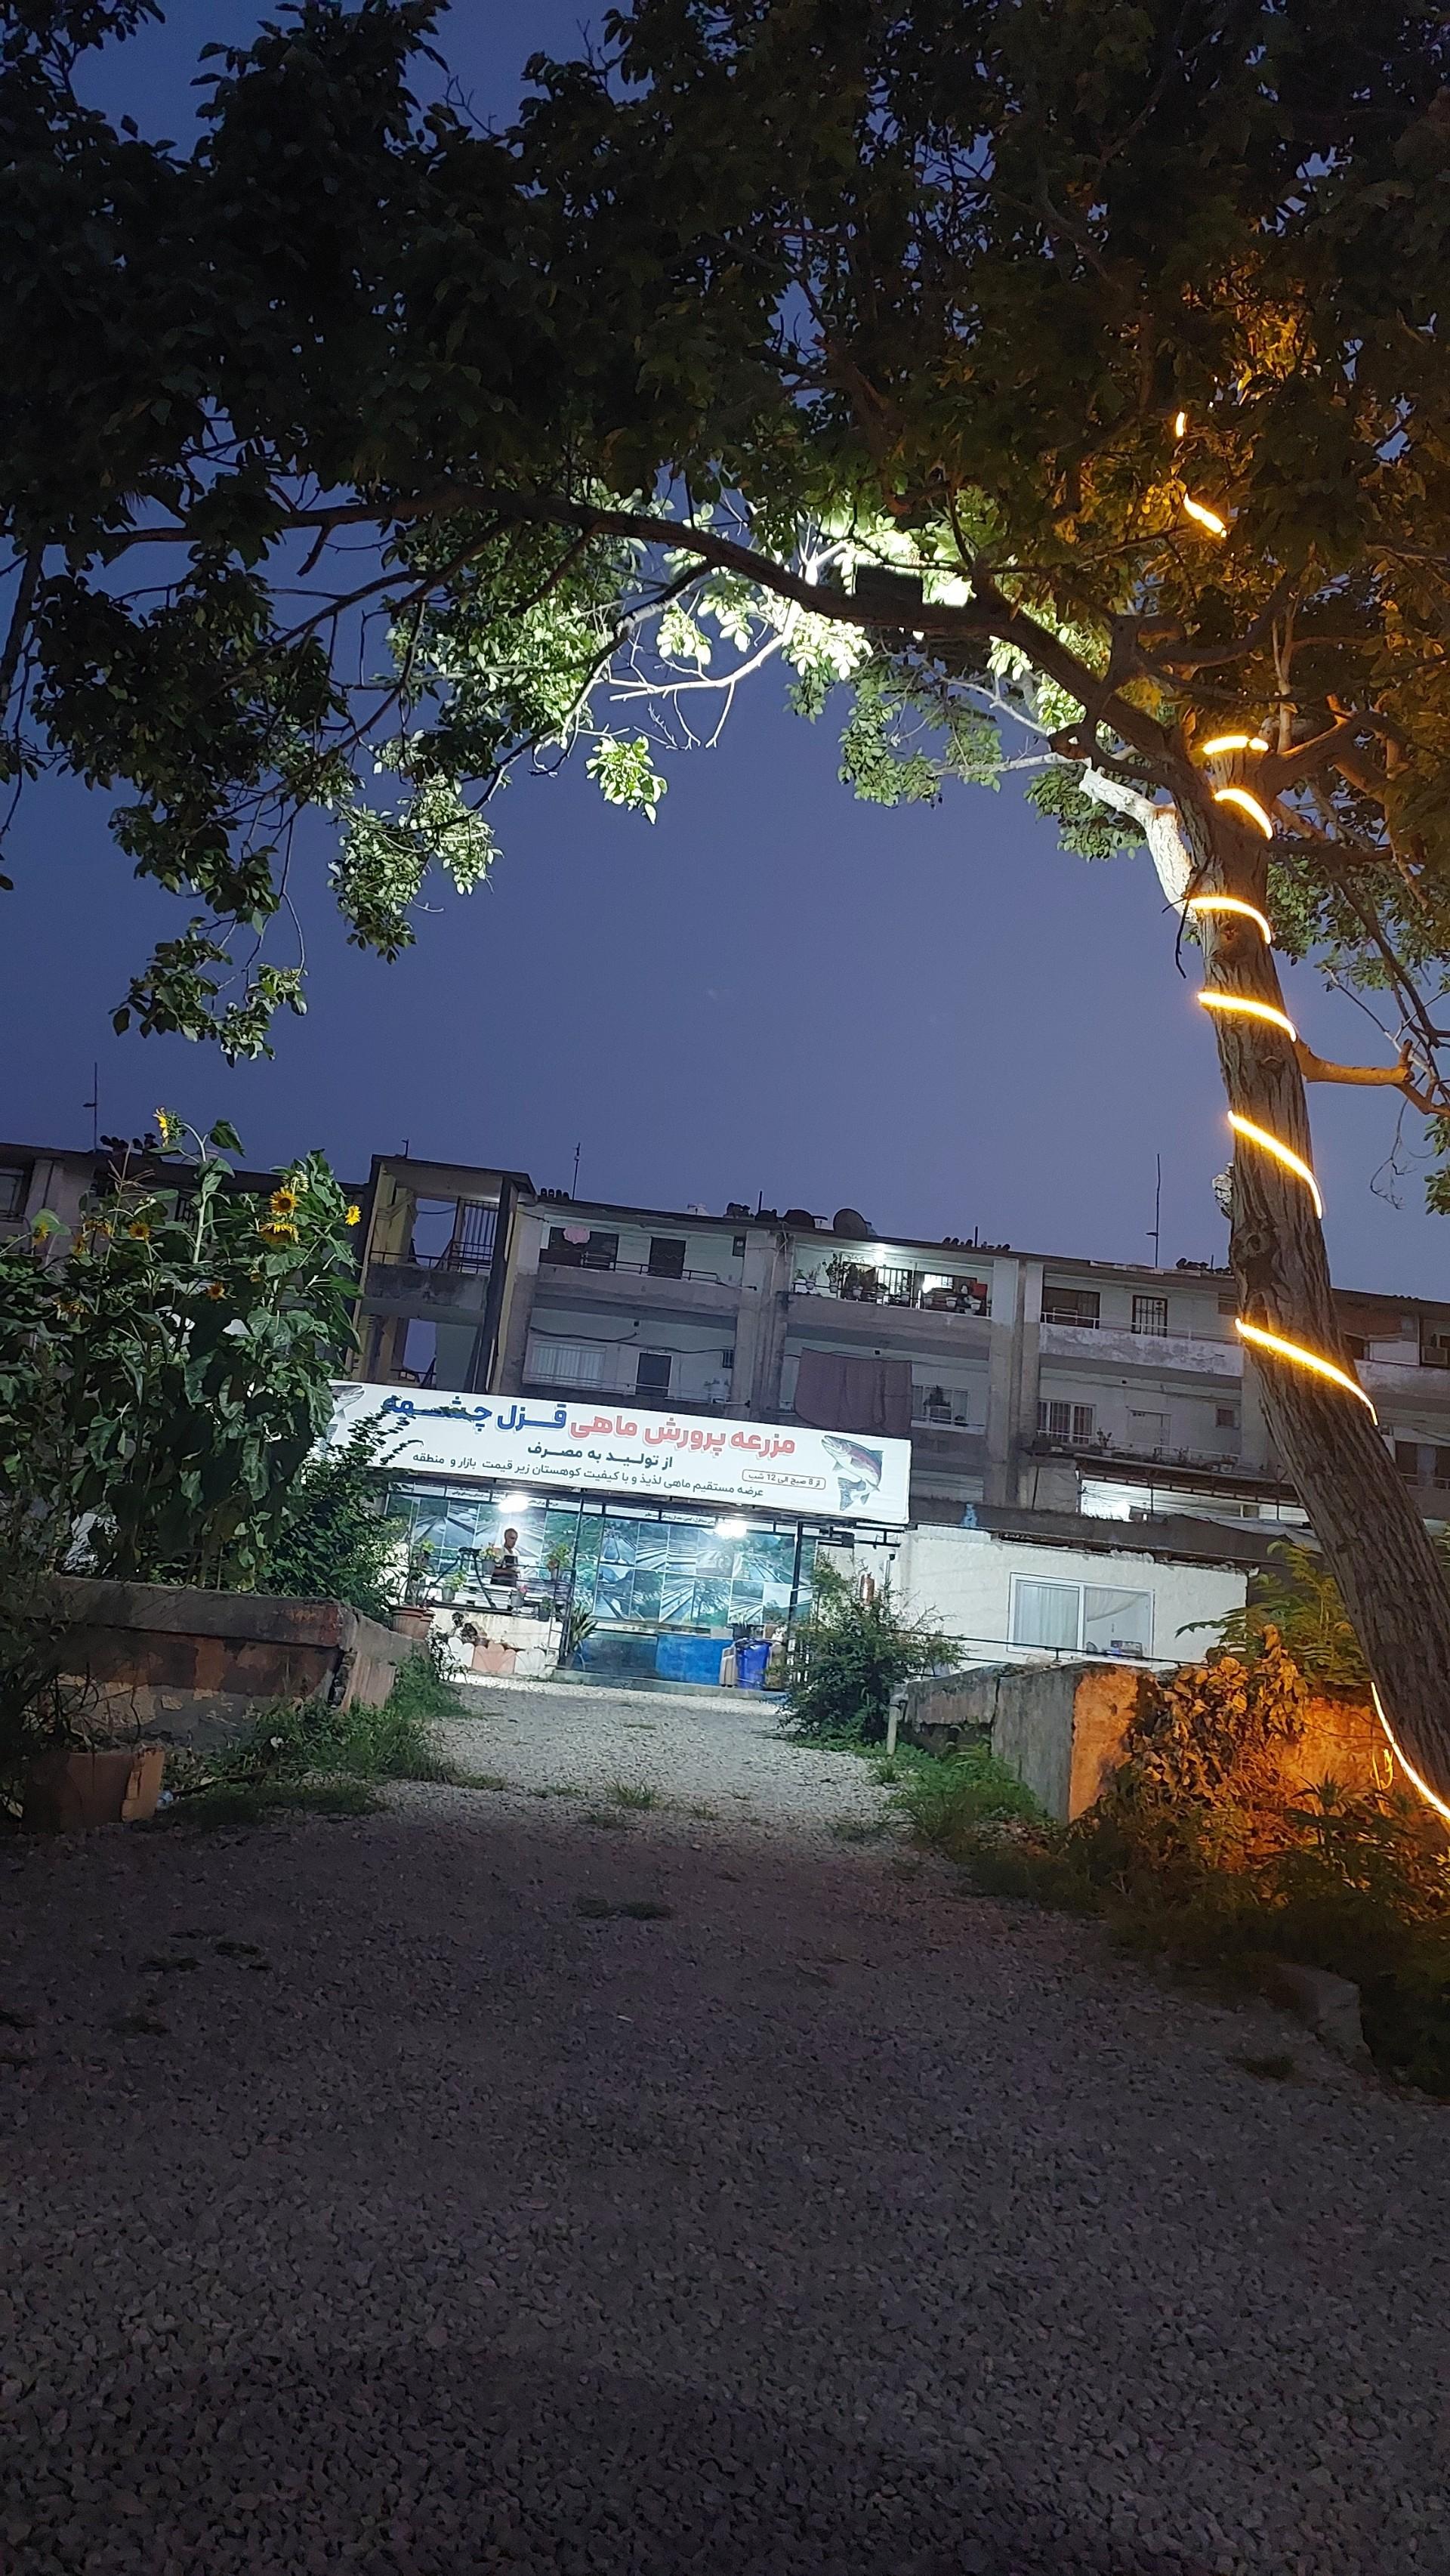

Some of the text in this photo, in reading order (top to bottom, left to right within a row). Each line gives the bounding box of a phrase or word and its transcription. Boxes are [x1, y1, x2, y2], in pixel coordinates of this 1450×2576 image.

[382, 1395, 795, 1458] مزرعه پرورش ماهی قزل چشمه
[412, 1453, 444, 1464] منطقه
[527, 1441, 673, 1470] از تولید به مصرف
[450, 1459, 455, 1467] و
[458, 1457, 477, 1469] بازار
[483, 1459, 513, 1472] قیمت
[514, 1464, 530, 1474] زیر
[532, 1464, 582, 1478] کوهستان
[584, 1470, 619, 1482] کیفیت
[622, 1472, 629, 1483] با
[640, 1473, 662, 1486] لذیذ
[664, 1479, 690, 1488] ماهی
[790, 1478, 807, 1486] صبح
[693, 1481, 734, 1493] مستقیم
[737, 1487, 764, 1497] عرضه
